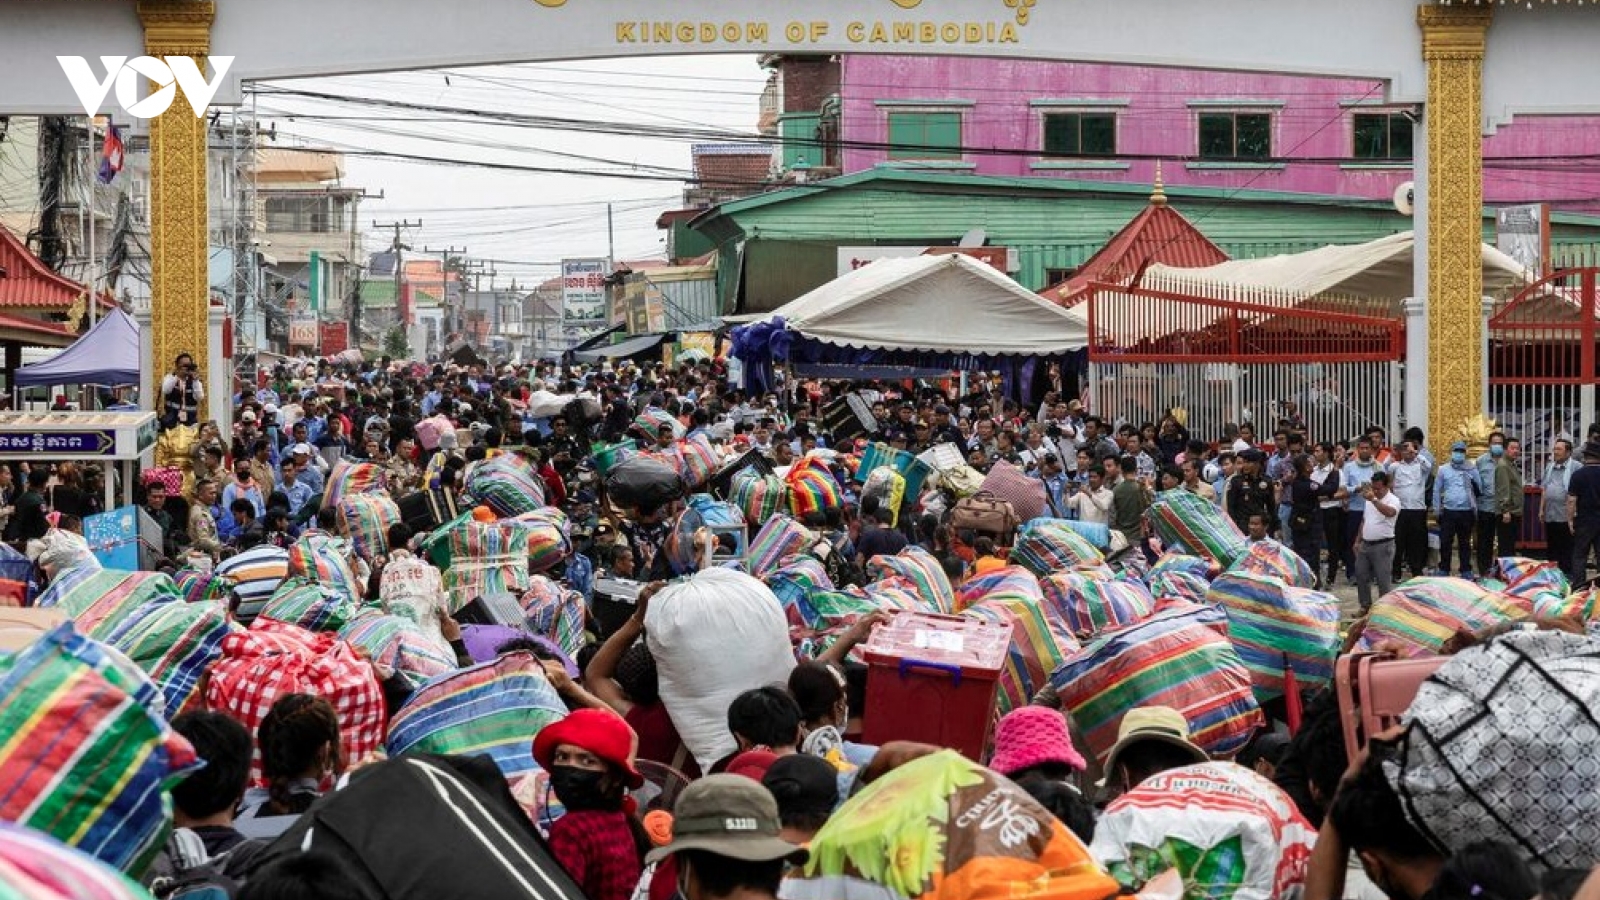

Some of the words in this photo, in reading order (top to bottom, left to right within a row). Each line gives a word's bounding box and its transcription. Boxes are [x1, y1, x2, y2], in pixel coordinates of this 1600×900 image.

[616, 21, 769, 42] KINGDOM
[786, 21, 828, 42] OF
[847, 21, 1019, 42] CAMBODIA
